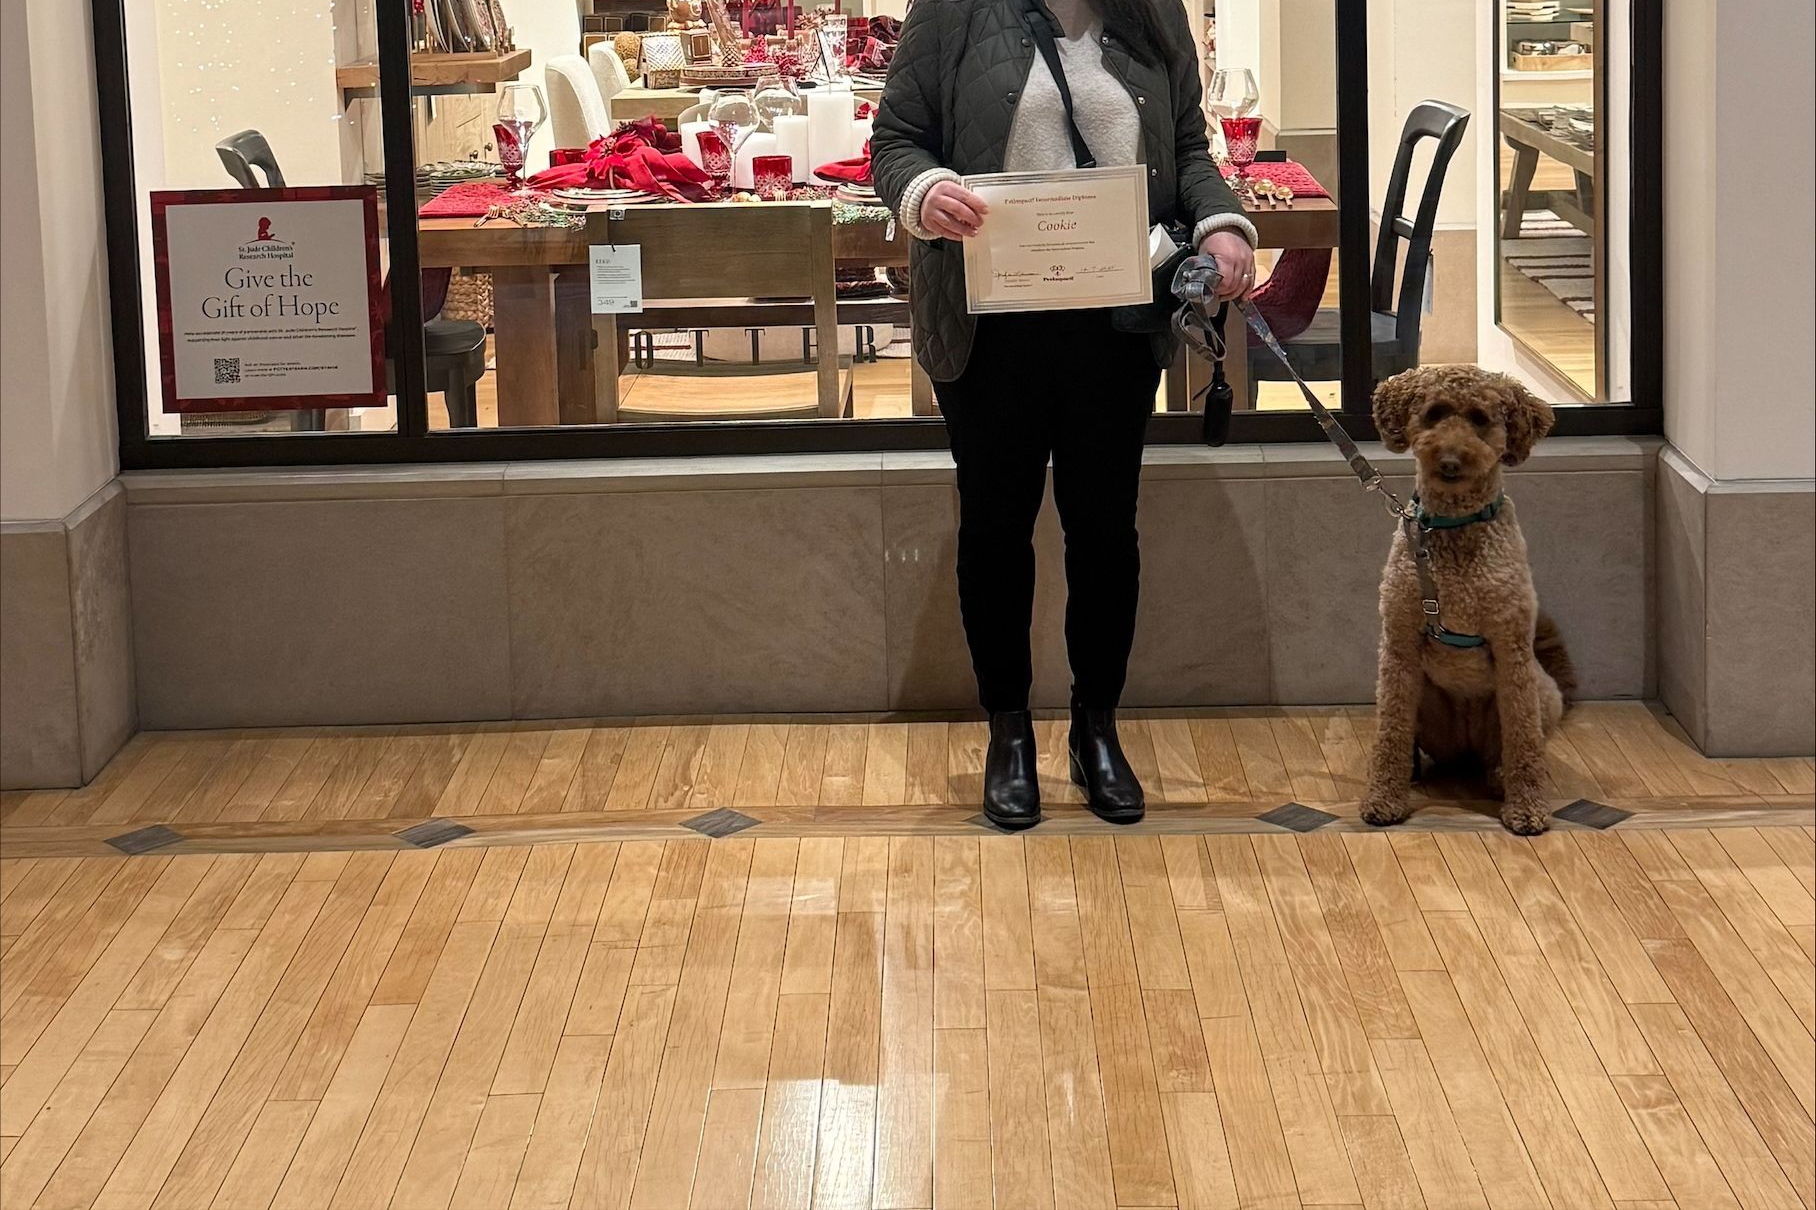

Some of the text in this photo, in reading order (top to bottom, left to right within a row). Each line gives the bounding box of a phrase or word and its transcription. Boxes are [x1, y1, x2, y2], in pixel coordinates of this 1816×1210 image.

[1037, 218, 1077, 232] Cookie
[247, 246, 261, 254] Jude
[261, 245, 293, 253] Children's
[267, 252, 294, 260] Hospital
[224, 264, 313, 290] Give the
[202, 293, 340, 324] Gift of Hope
